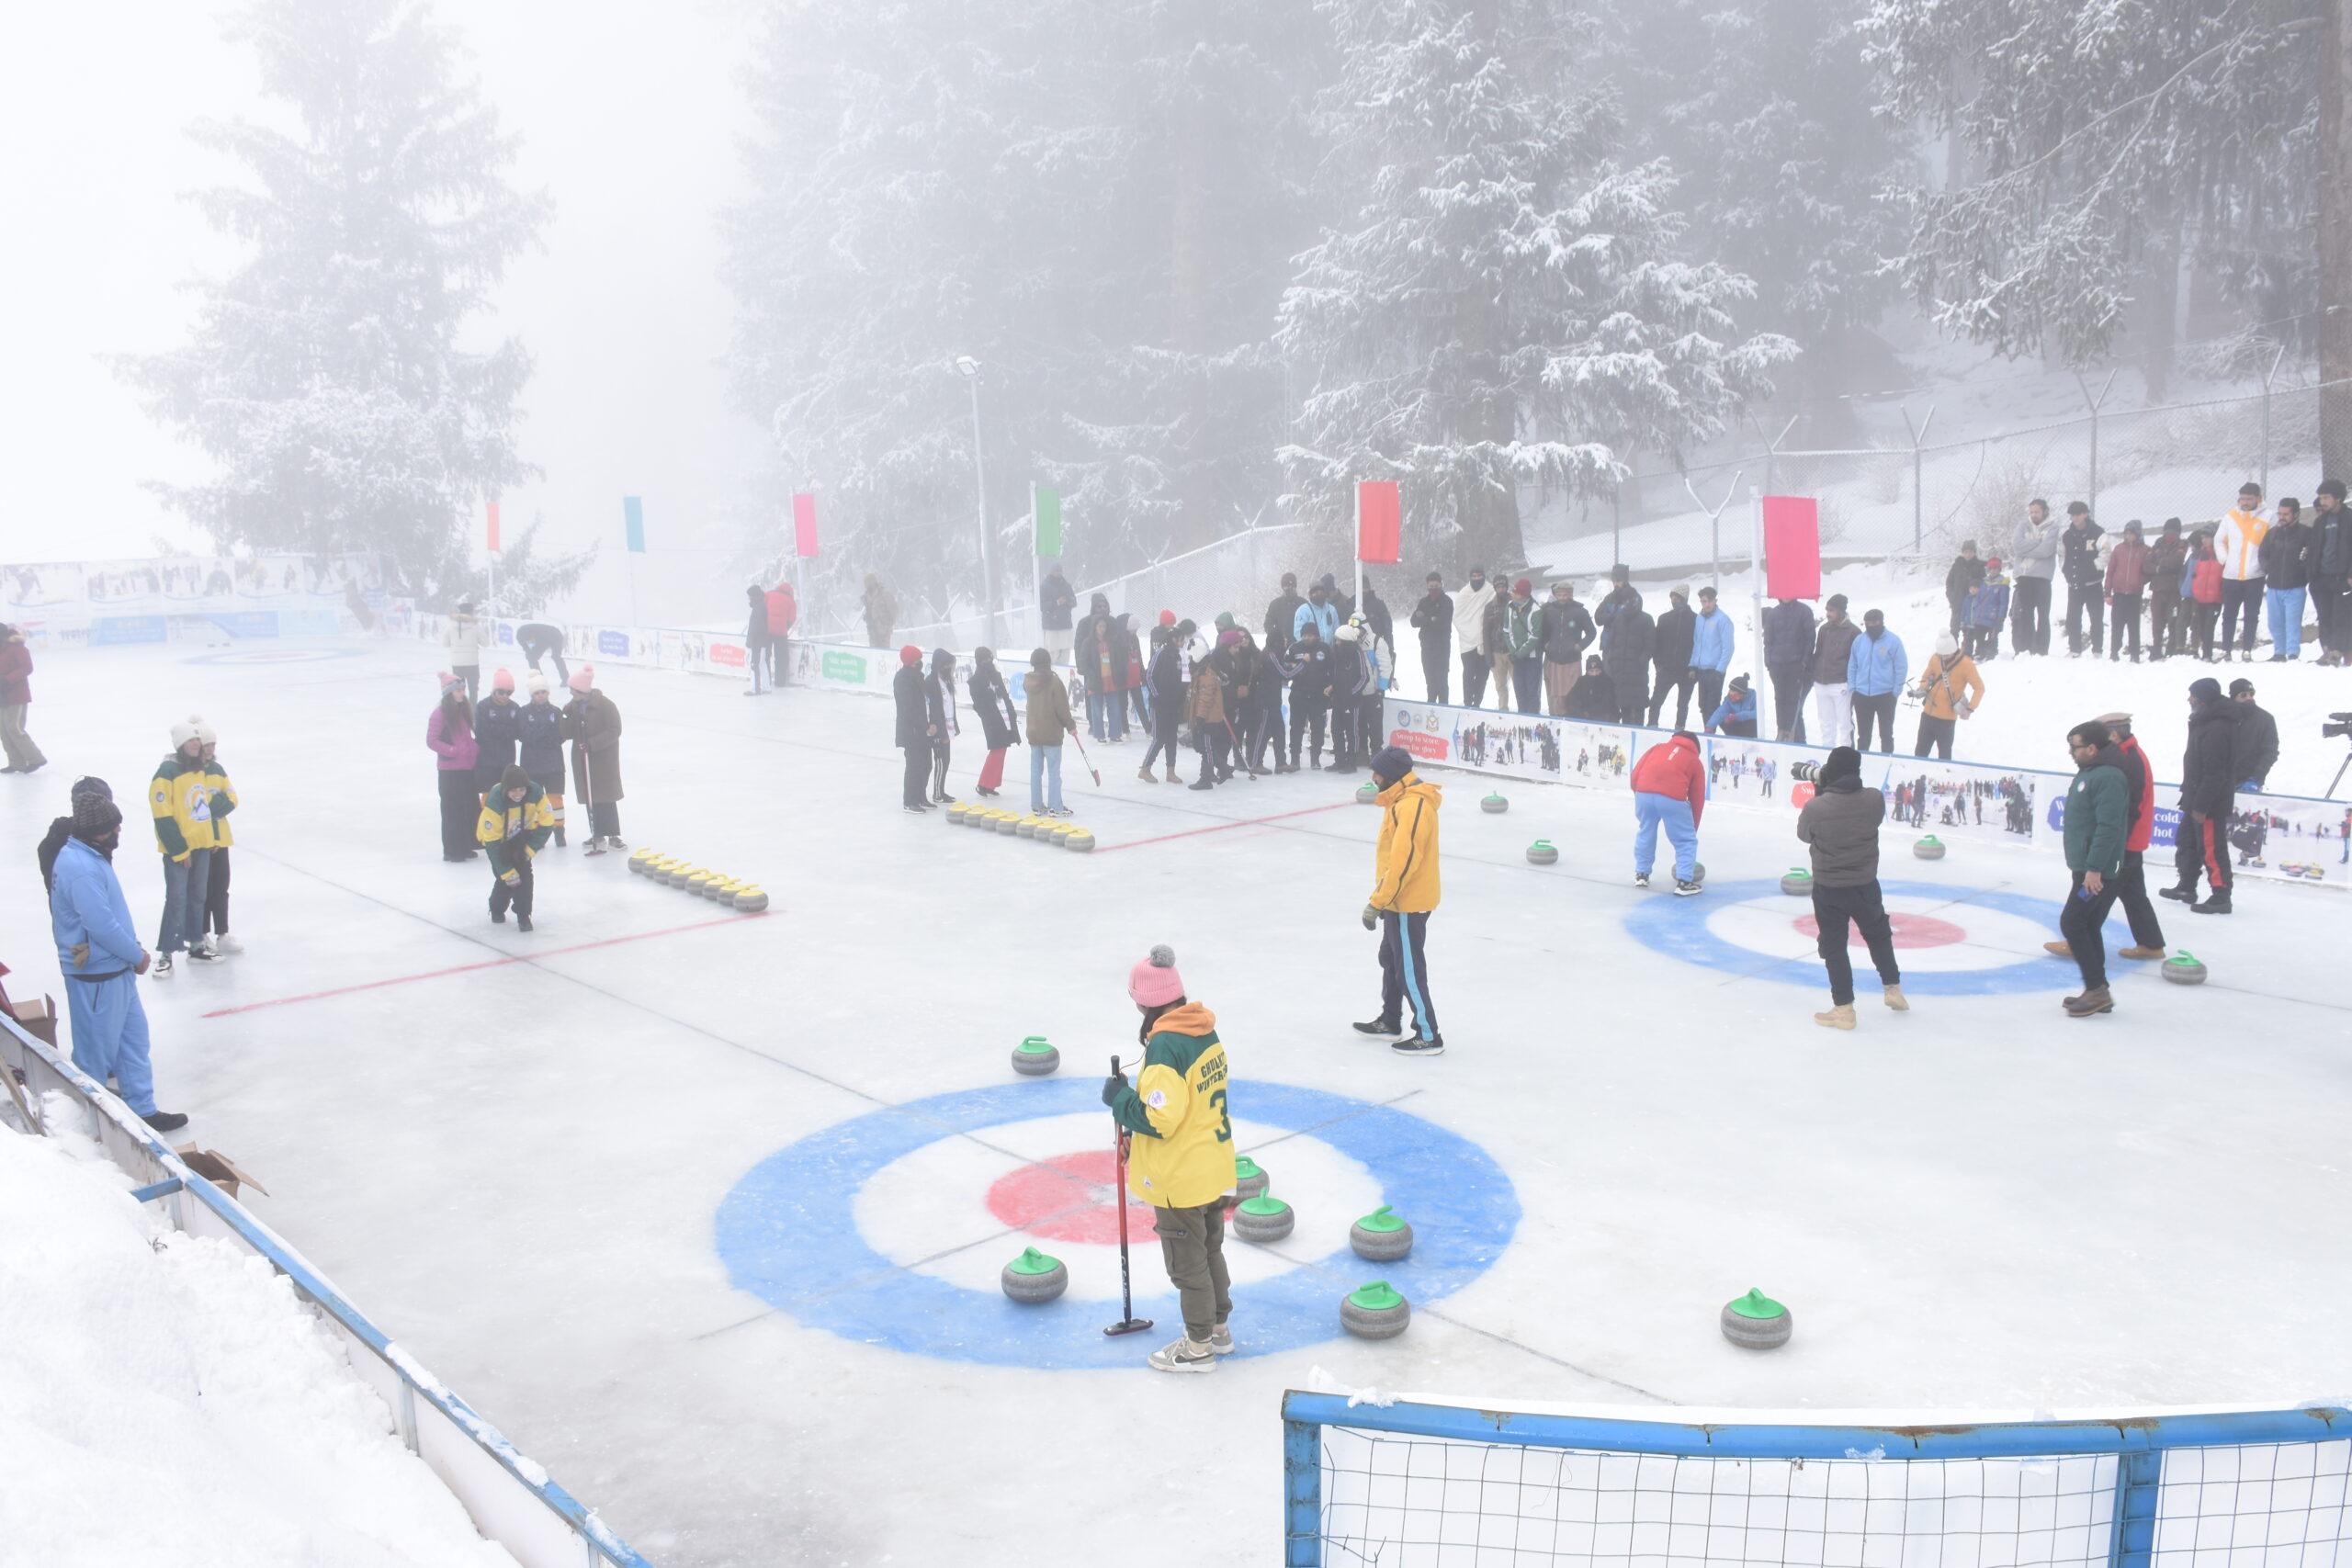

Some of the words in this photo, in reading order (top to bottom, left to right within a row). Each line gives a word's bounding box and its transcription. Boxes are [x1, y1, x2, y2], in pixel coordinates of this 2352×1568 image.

[2086, 539, 2096, 551] K
[2153, 826, 2174, 838] hot
[1210, 1089, 1231, 1142] 3
